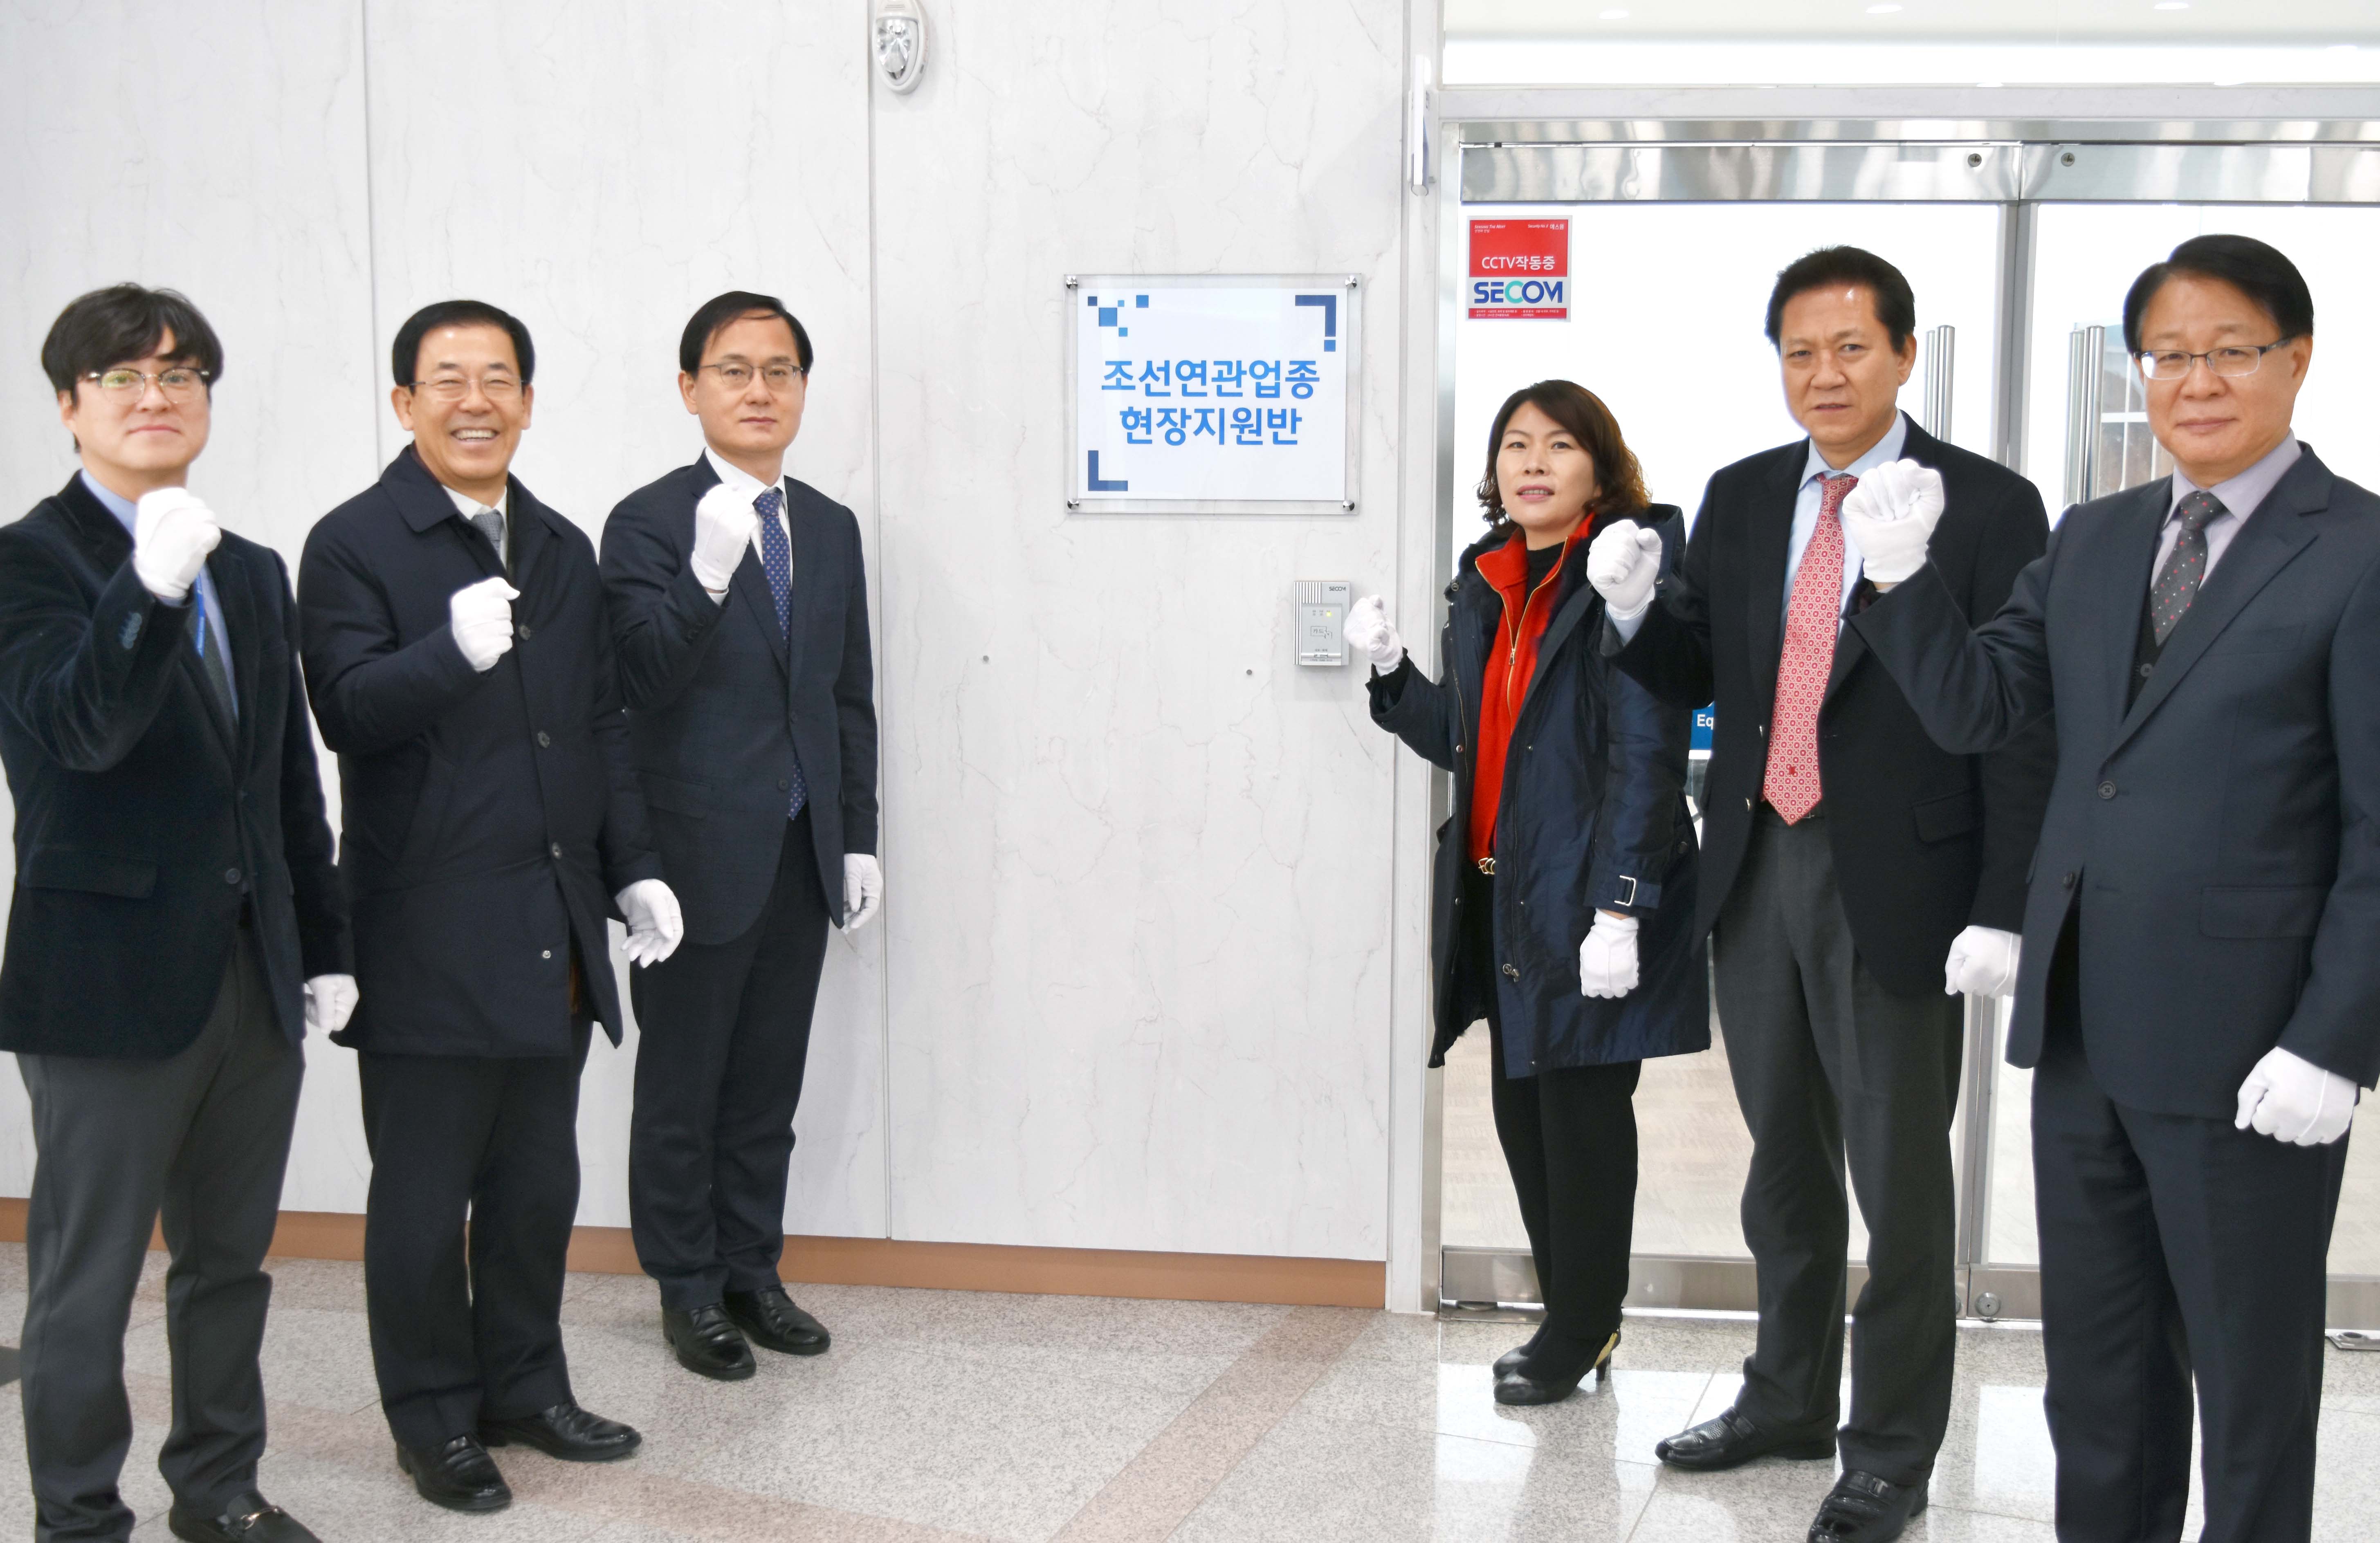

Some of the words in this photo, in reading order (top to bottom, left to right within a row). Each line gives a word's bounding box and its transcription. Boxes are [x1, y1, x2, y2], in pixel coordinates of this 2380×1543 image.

[1482, 256, 1555, 270] CCTV작동중
[1474, 280, 1563, 303] SECOM
[1101, 360, 1320, 399] 조선연관업종
[1120, 406, 1302, 446] 현장지원반
